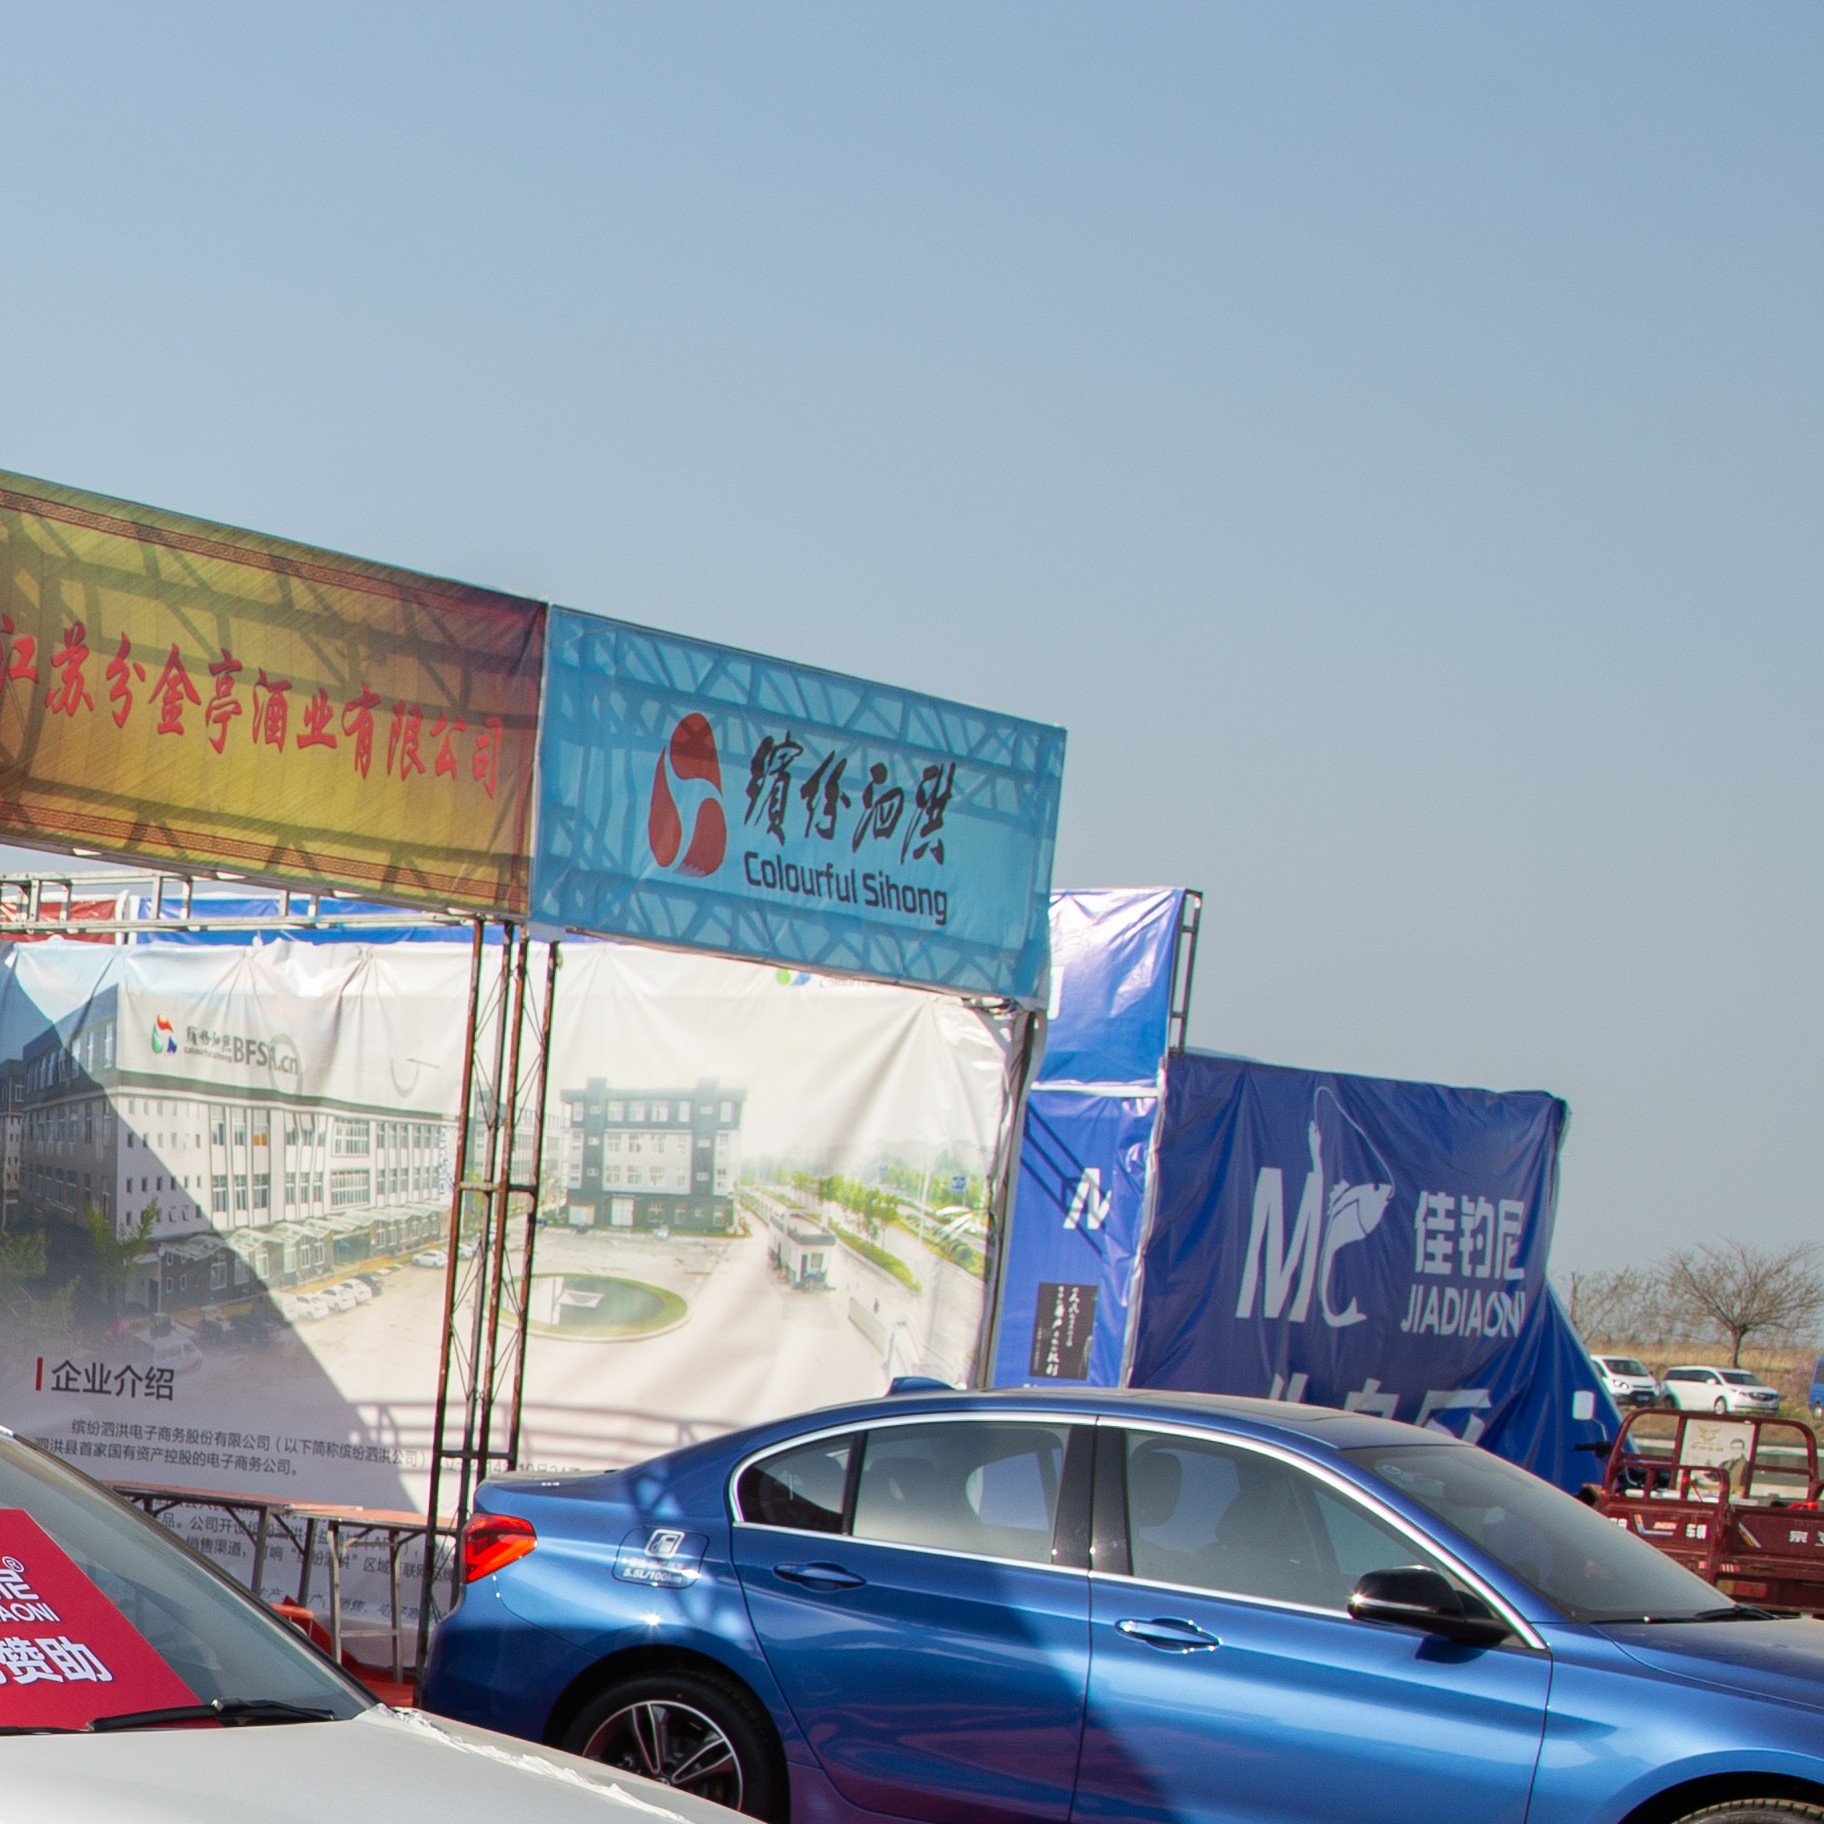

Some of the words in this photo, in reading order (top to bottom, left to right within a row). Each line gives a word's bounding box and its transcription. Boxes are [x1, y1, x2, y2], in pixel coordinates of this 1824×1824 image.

[743, 850, 858, 905] Colourful
[862, 869, 949, 927] Sihong
[1414, 1190, 1526, 1281] 佳钓尼
[50, 1359, 175, 1402] 企业介绍
